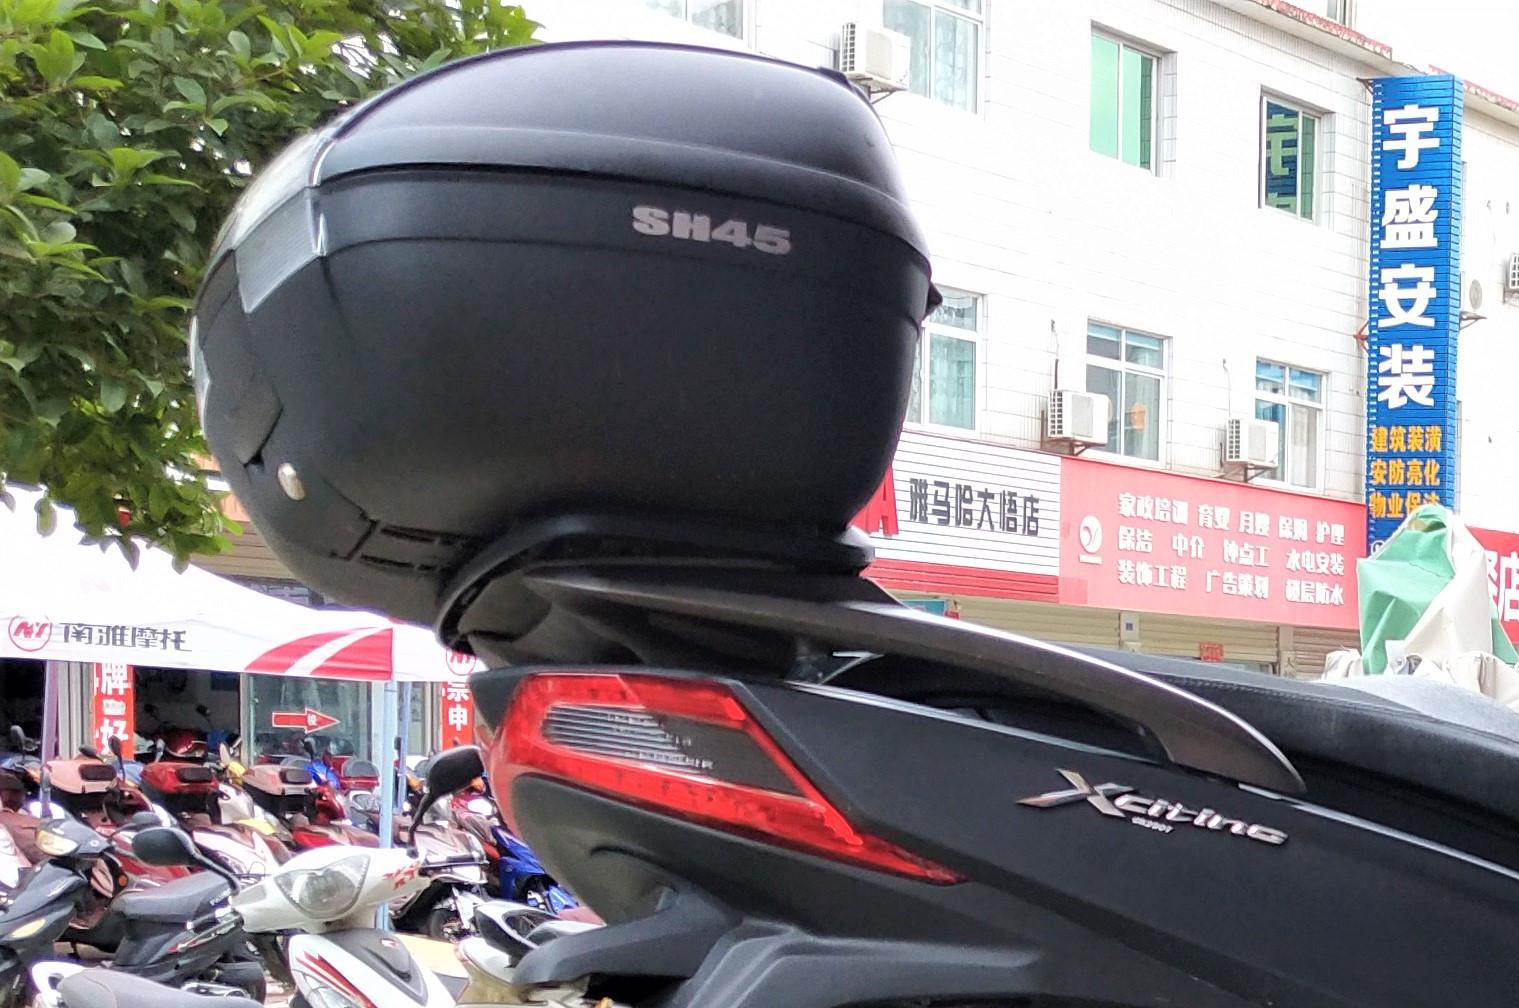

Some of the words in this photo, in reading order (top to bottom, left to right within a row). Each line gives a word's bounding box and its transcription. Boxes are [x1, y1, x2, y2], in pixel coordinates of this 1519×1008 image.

[632, 205, 791, 255] SH45
[1377, 104, 1440, 410] 宇盛安装
[1371, 458, 1440, 485] 安防亮化
[910, 478, 1039, 536] 雅马哈大悟店
[1119, 492, 1188, 524] 家政培训
[1198, 504, 1230, 530] 育婴
[1239, 511, 1270, 536] 月嫂
[1278, 515, 1308, 541] 保姆
[1316, 520, 1344, 545] 护理
[1118, 525, 1153, 552] 保洁
[1172, 533, 1205, 559] 中介
[1223, 539, 1271, 566] 钟点工
[1286, 549, 1345, 575] 水电安装
[1118, 559, 1187, 589] 装饰工程
[1206, 569, 1269, 598] 广告策划
[59, 622, 192, 652] 南雅摩托
